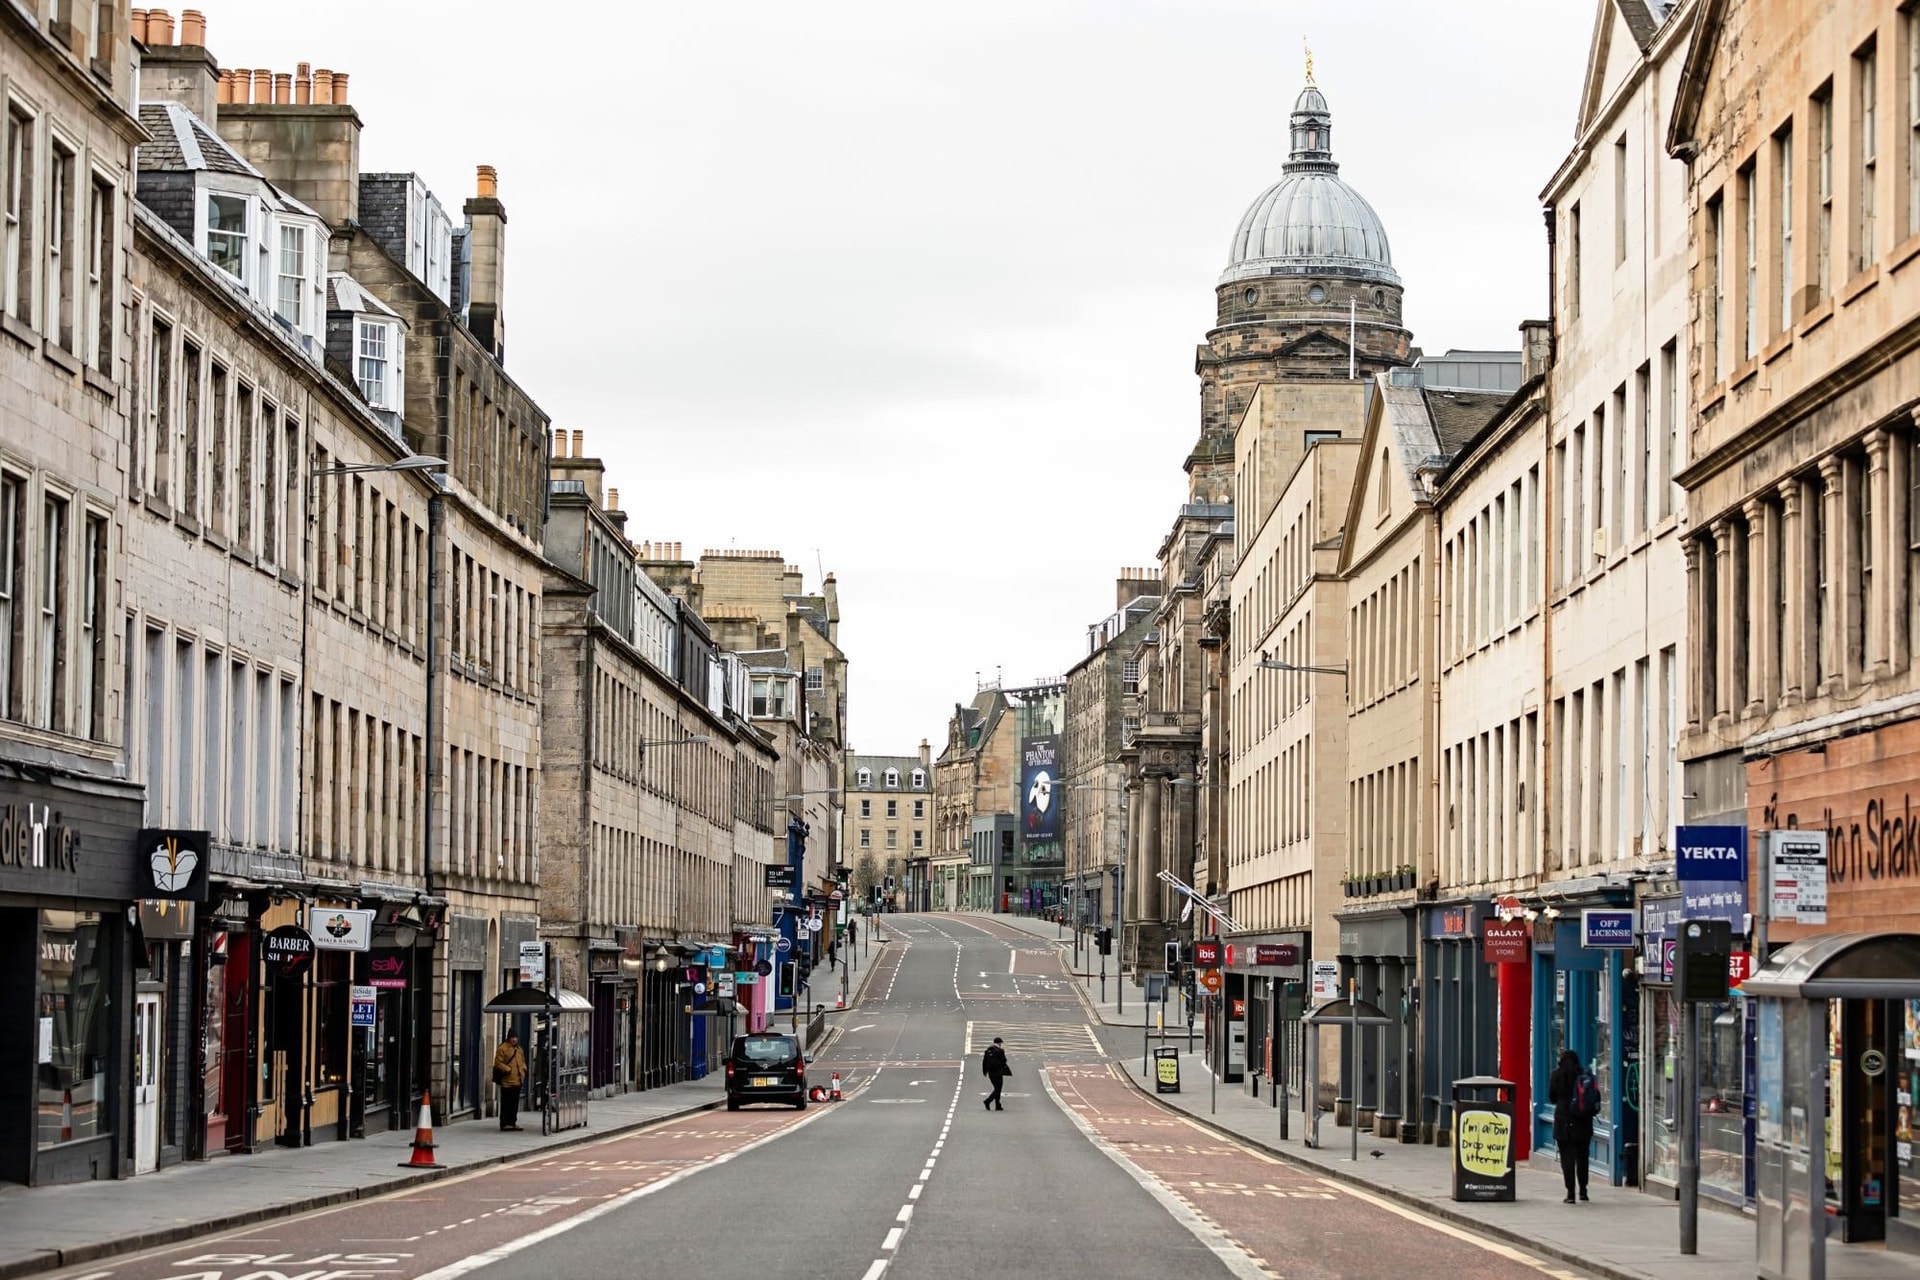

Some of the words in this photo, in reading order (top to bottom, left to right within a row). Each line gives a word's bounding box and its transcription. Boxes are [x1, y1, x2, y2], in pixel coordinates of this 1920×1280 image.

[1025, 749, 1055, 762] PHANTOM
[1866, 792, 1920, 881] Shak
[1681, 847, 1738, 860] YEKTA
[1599, 919, 1620, 928] OFF
[1487, 929, 1524, 937] GALAXY
[1589, 929, 1631, 937] LICENSE
[269, 936, 310, 952] BARBER
[1199, 949, 1215, 959] ibis
[371, 957, 404, 975] sally
[1462, 1139, 1484, 1152] Drop
[172, 1253, 414, 1266] BUS
